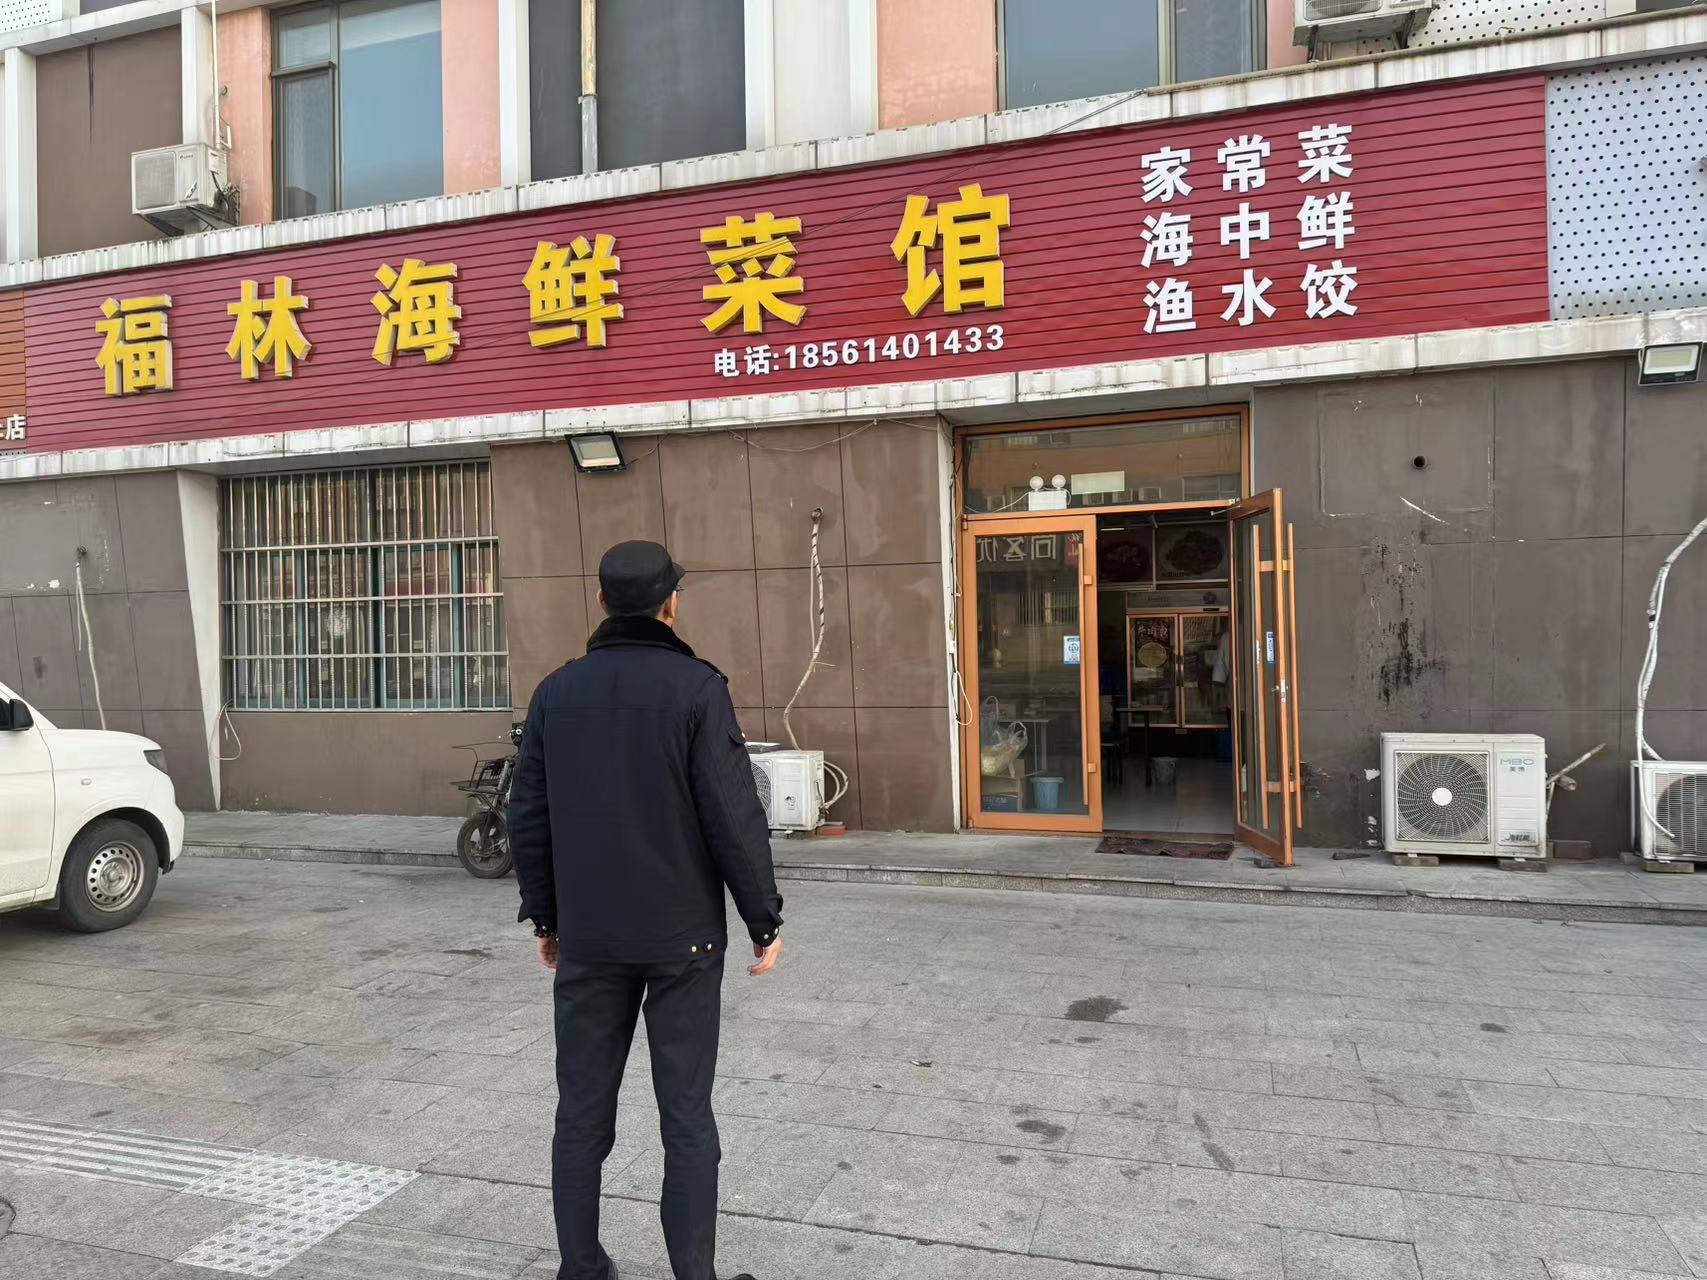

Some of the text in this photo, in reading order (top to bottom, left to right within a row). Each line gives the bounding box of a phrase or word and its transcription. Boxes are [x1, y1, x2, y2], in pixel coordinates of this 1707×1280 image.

[1140, 123, 1354, 204] 家常菜
[1140, 191, 1356, 269] 海中鲜
[95, 184, 1011, 396] 福林海鲜菜馆
[1143, 259, 1359, 335] 渔水饺
[0, 413, 27, 442] 店
